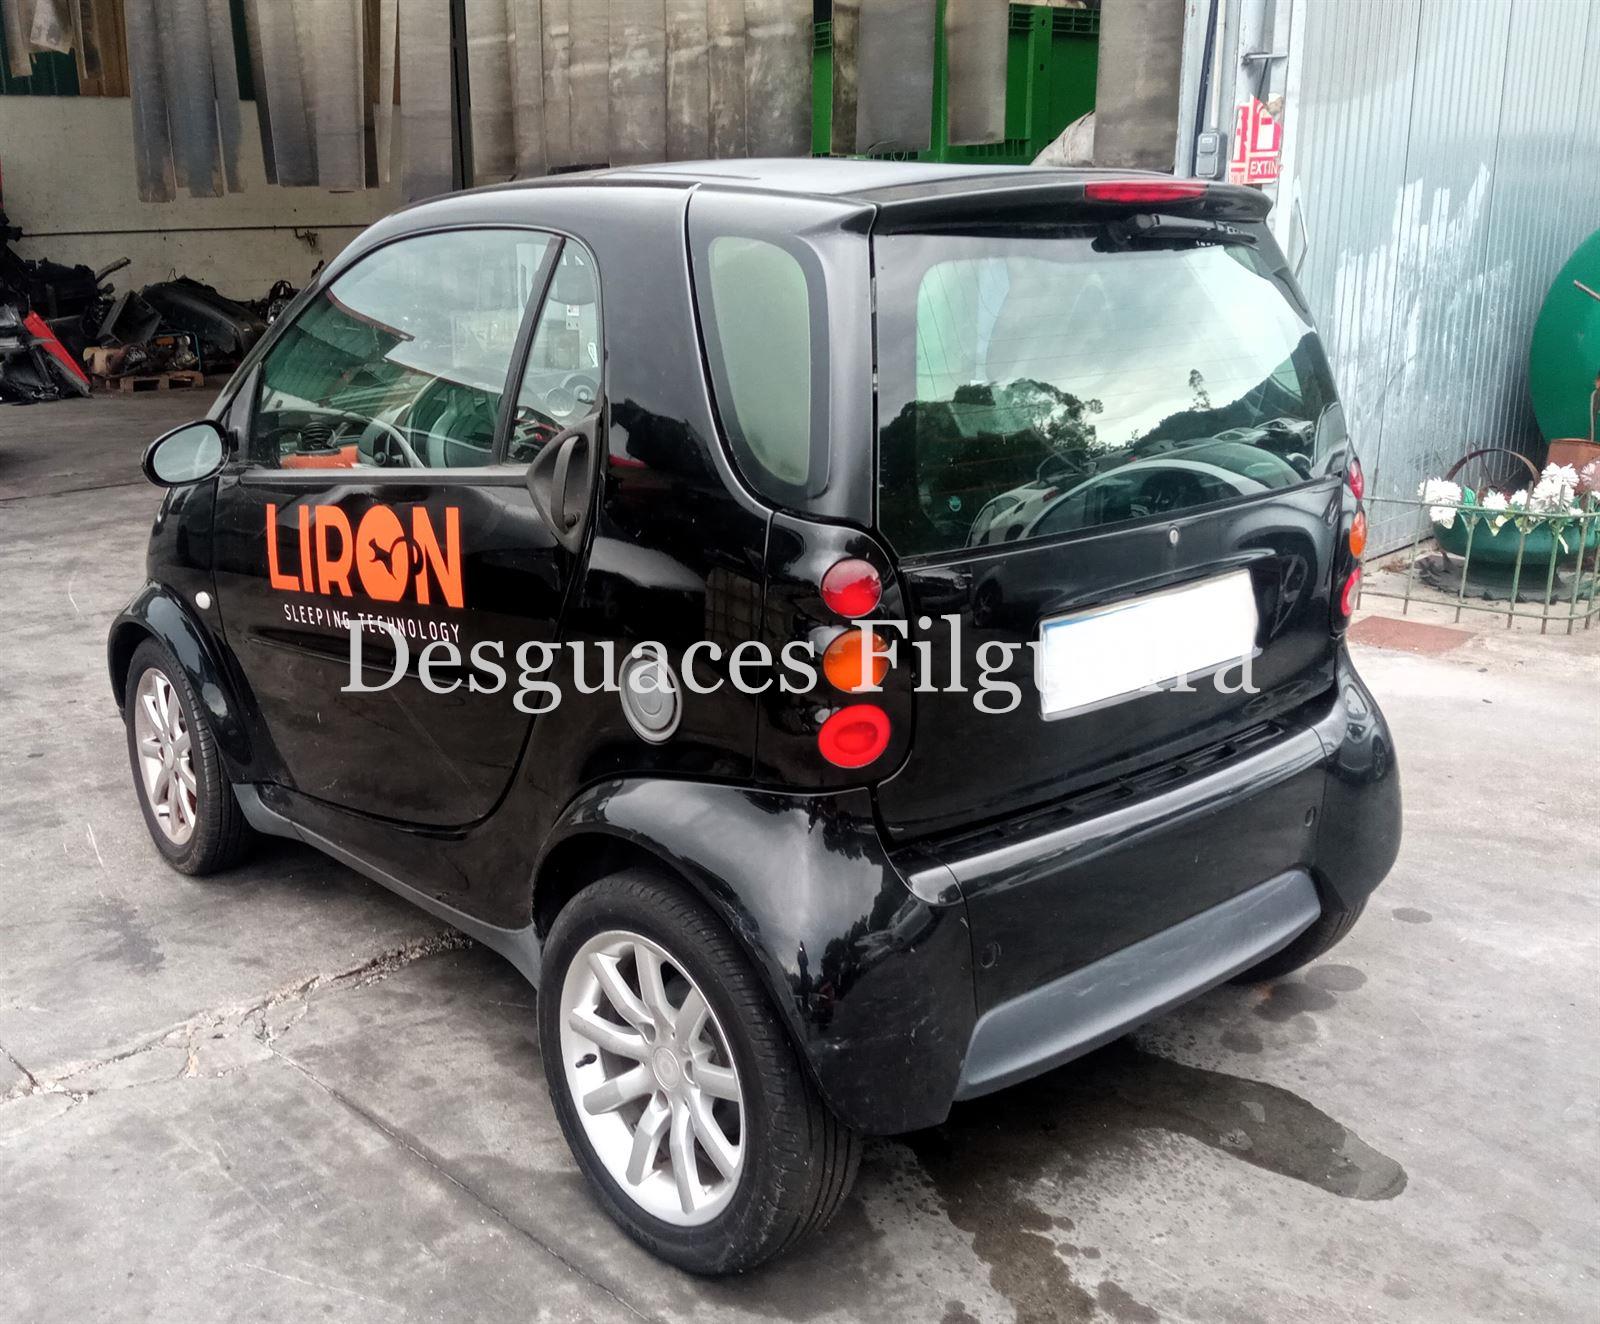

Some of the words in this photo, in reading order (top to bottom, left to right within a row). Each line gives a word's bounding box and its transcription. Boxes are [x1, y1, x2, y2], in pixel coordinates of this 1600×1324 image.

[266, 503, 464, 608] LIRON
[283, 604, 351, 630] SLEEPING
[357, 612, 460, 644] TECHNOLOGY
